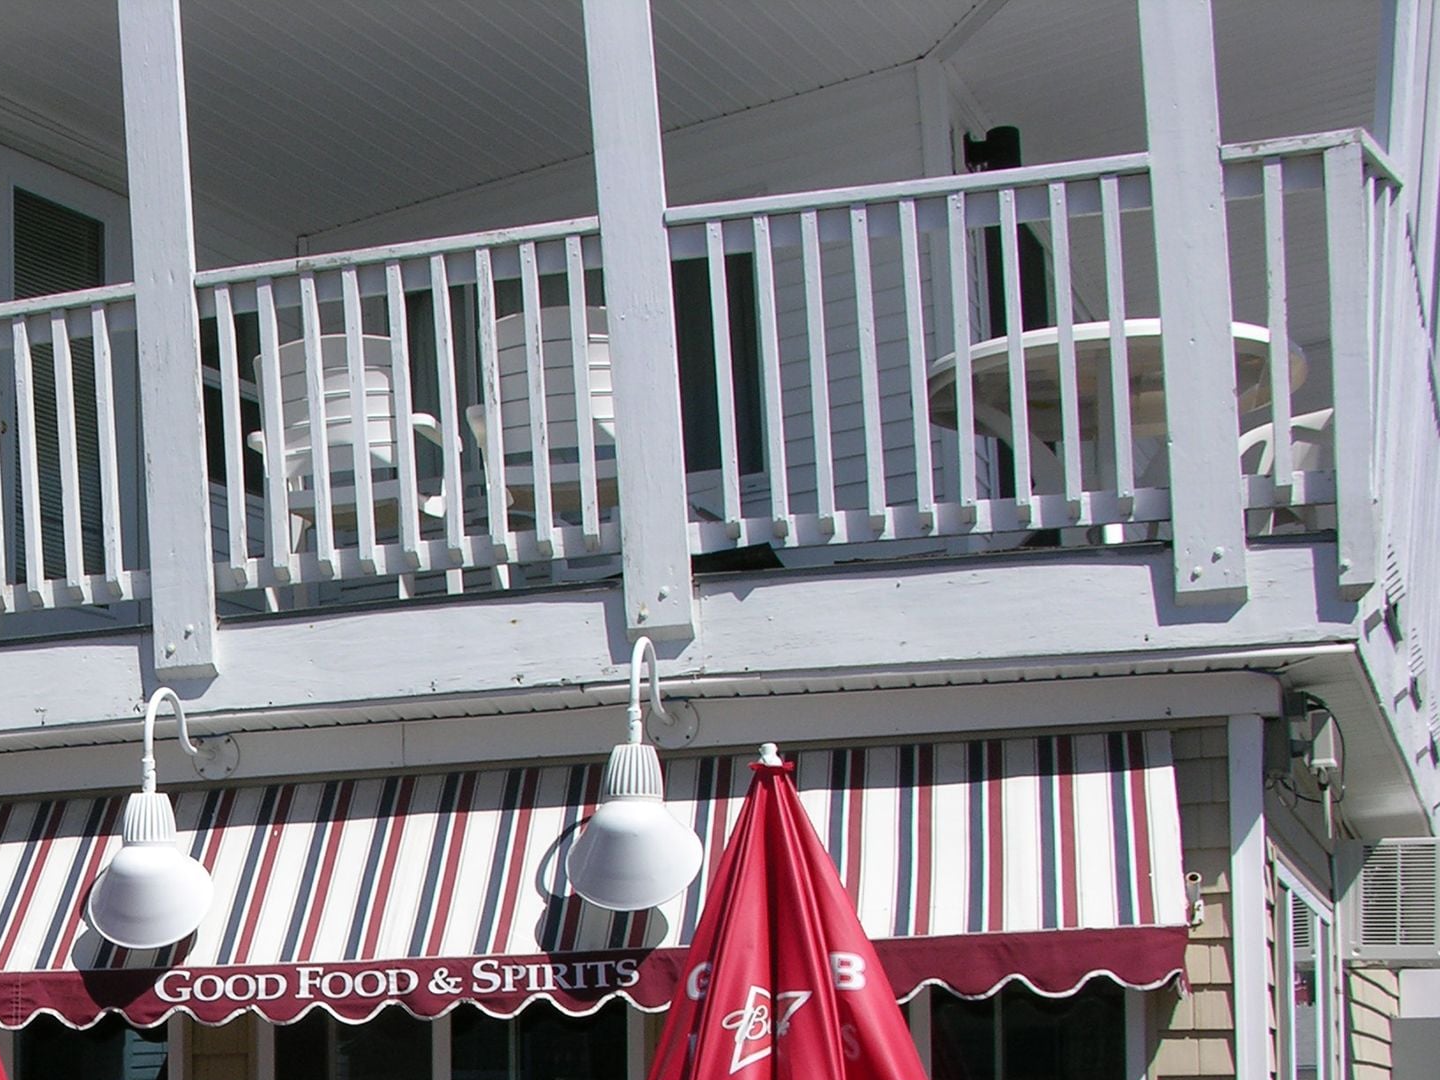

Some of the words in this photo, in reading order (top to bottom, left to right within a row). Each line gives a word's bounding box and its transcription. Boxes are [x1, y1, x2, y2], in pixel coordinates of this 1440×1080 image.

[153, 970, 288, 1002] GOOD
[295, 966, 419, 999] FOOD
[427, 966, 462, 995] &
[471, 958, 639, 993] SPIRITS
